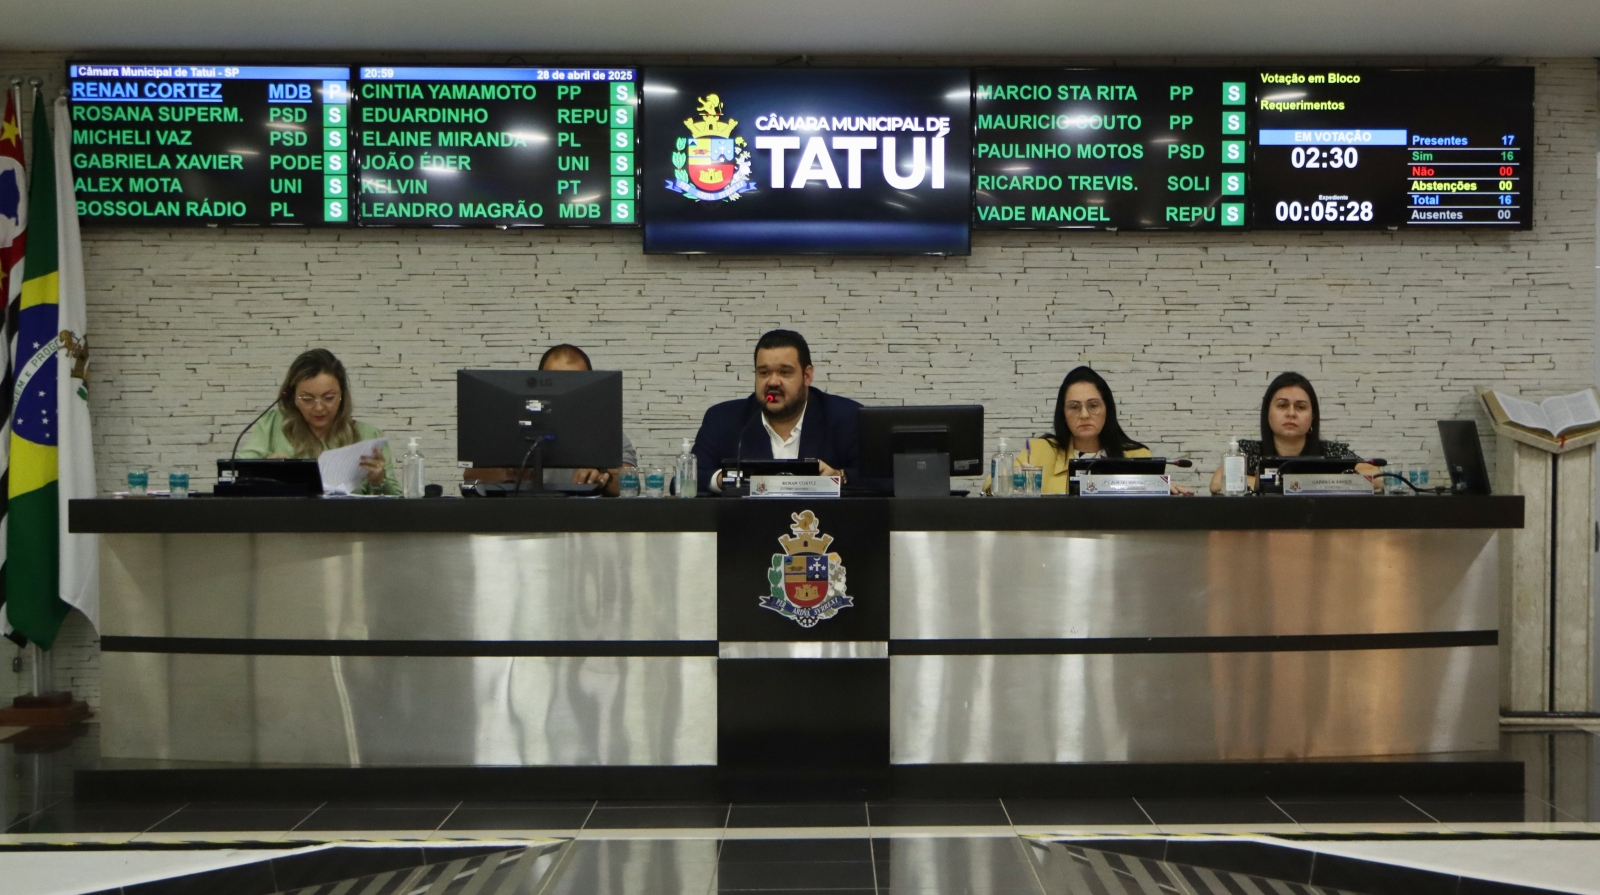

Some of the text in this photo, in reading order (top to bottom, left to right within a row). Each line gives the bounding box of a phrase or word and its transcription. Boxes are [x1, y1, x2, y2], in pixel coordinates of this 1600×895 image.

[79, 66, 119, 76] Câmara
[121, 66, 172, 78] Municipal
[174, 67, 188, 77] de
[224, 67, 239, 77] SP
[364, 68, 632, 80] 20:59 28 de abril de 2025
[1261, 73, 1360, 85] Votação em Bloco
[72, 82, 342, 99] RENAN CORTEZ MDB P
[362, 84, 630, 101] CINTIA YAMAMOTO PP S
[976, 84, 1240, 101] MARCIO STA RITA PP S
[1260, 100, 1345, 111] Requerimentos
[73, 106, 341, 123] ROSANA SUPERM. PSD S
[363, 108, 628, 124] EDUARDINHO REPU S
[755, 113, 950, 132] CÂMARA MUNICIPAL DE
[977, 114, 1240, 131] MAURICIO COUTO PP S
[74, 129, 341, 146] MICHELI VAZ PSD S
[363, 130, 628, 148] ELAINE MIRANDA PL S
[1294, 130, 1371, 144] EM VOTAÇÃO
[1412, 135, 1515, 145] Presentes 17
[755, 130, 950, 189] TATUÍ
[978, 144, 1239, 159] PAULINHO MOTOS PSD S
[1292, 147, 1358, 168] 02:30
[1413, 151, 1513, 160] Sim 16
[74, 154, 342, 170] GABRIELA XAVIER PODE S
[362, 151, 628, 171] JOÃO ÉDER UNI S
[1412, 164, 1513, 176] Não 00
[75, 178, 342, 194] ALEX MOTA UNI S
[362, 179, 628, 195] KELVIN PT S
[977, 175, 1239, 191] RICARDO TREVIS. SOLI S
[1411, 180, 1512, 193] Abstenções 00
[76, 198, 342, 217] BOSSOLAN RÁDIO PL S
[1412, 195, 1512, 205] Total 16
[362, 200, 628, 218] LEANDRO MAGRÃO MDB S
[977, 206, 1238, 222] VADE MANOEL REPU S
[1275, 201, 1374, 221] 00:05:28
[1412, 210, 1511, 219] Ausentes 00
